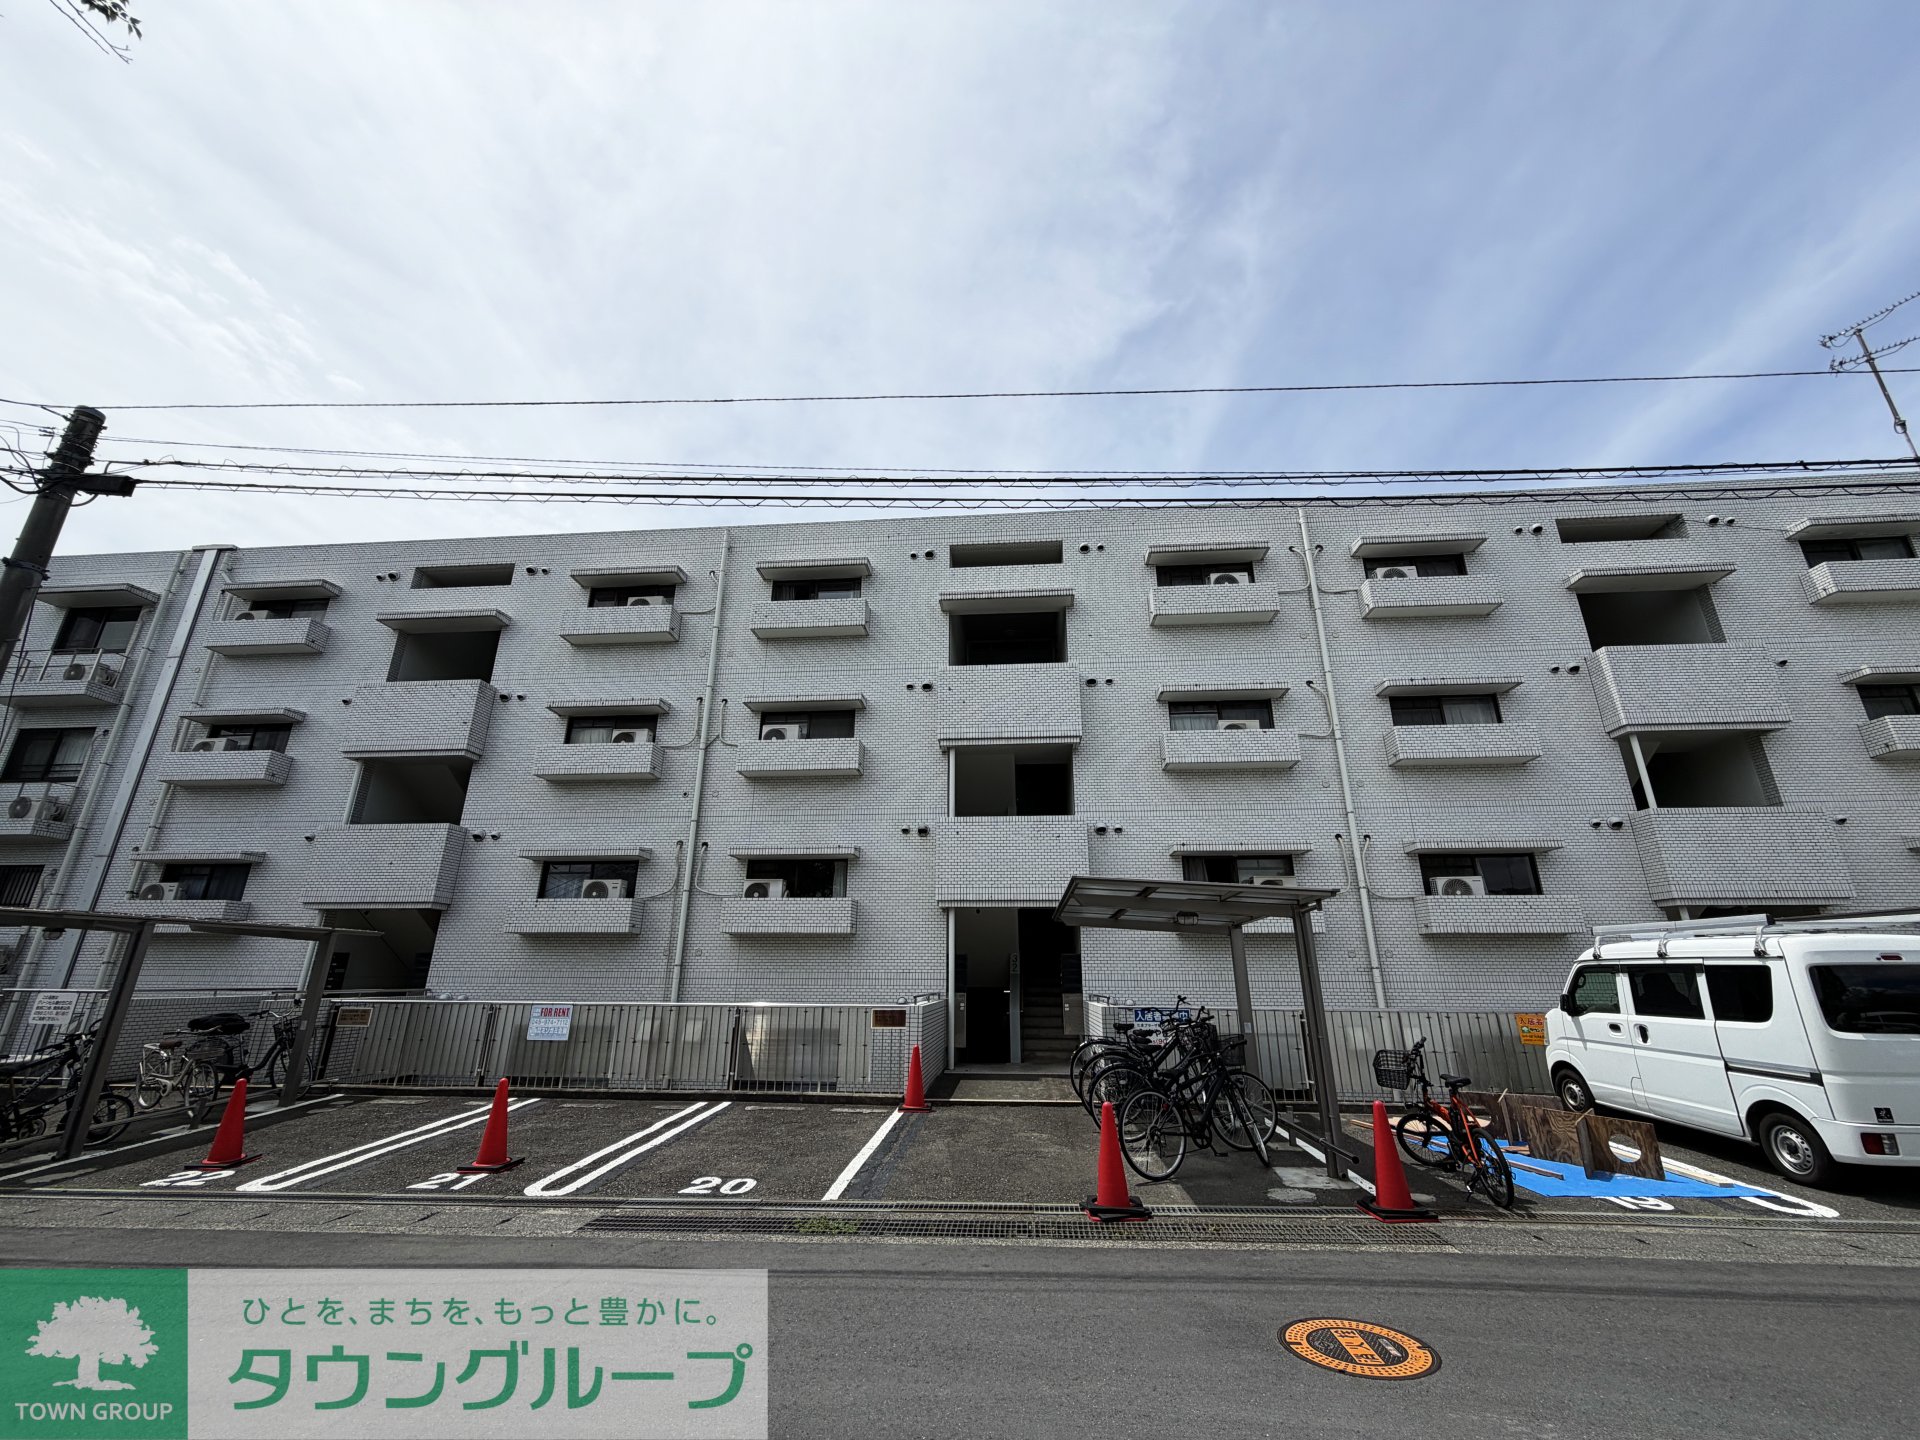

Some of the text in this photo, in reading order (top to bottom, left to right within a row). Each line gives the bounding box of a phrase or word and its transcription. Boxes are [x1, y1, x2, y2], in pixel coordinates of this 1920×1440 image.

[540, 1007, 553, 1017] FOR
[553, 1007, 570, 1018] RENT
[1136, 1011, 1189, 1022] 入居者中
[139, 1170, 236, 1187] 22
[405, 1172, 489, 1190] 21
[678, 1176, 757, 1194] 20
